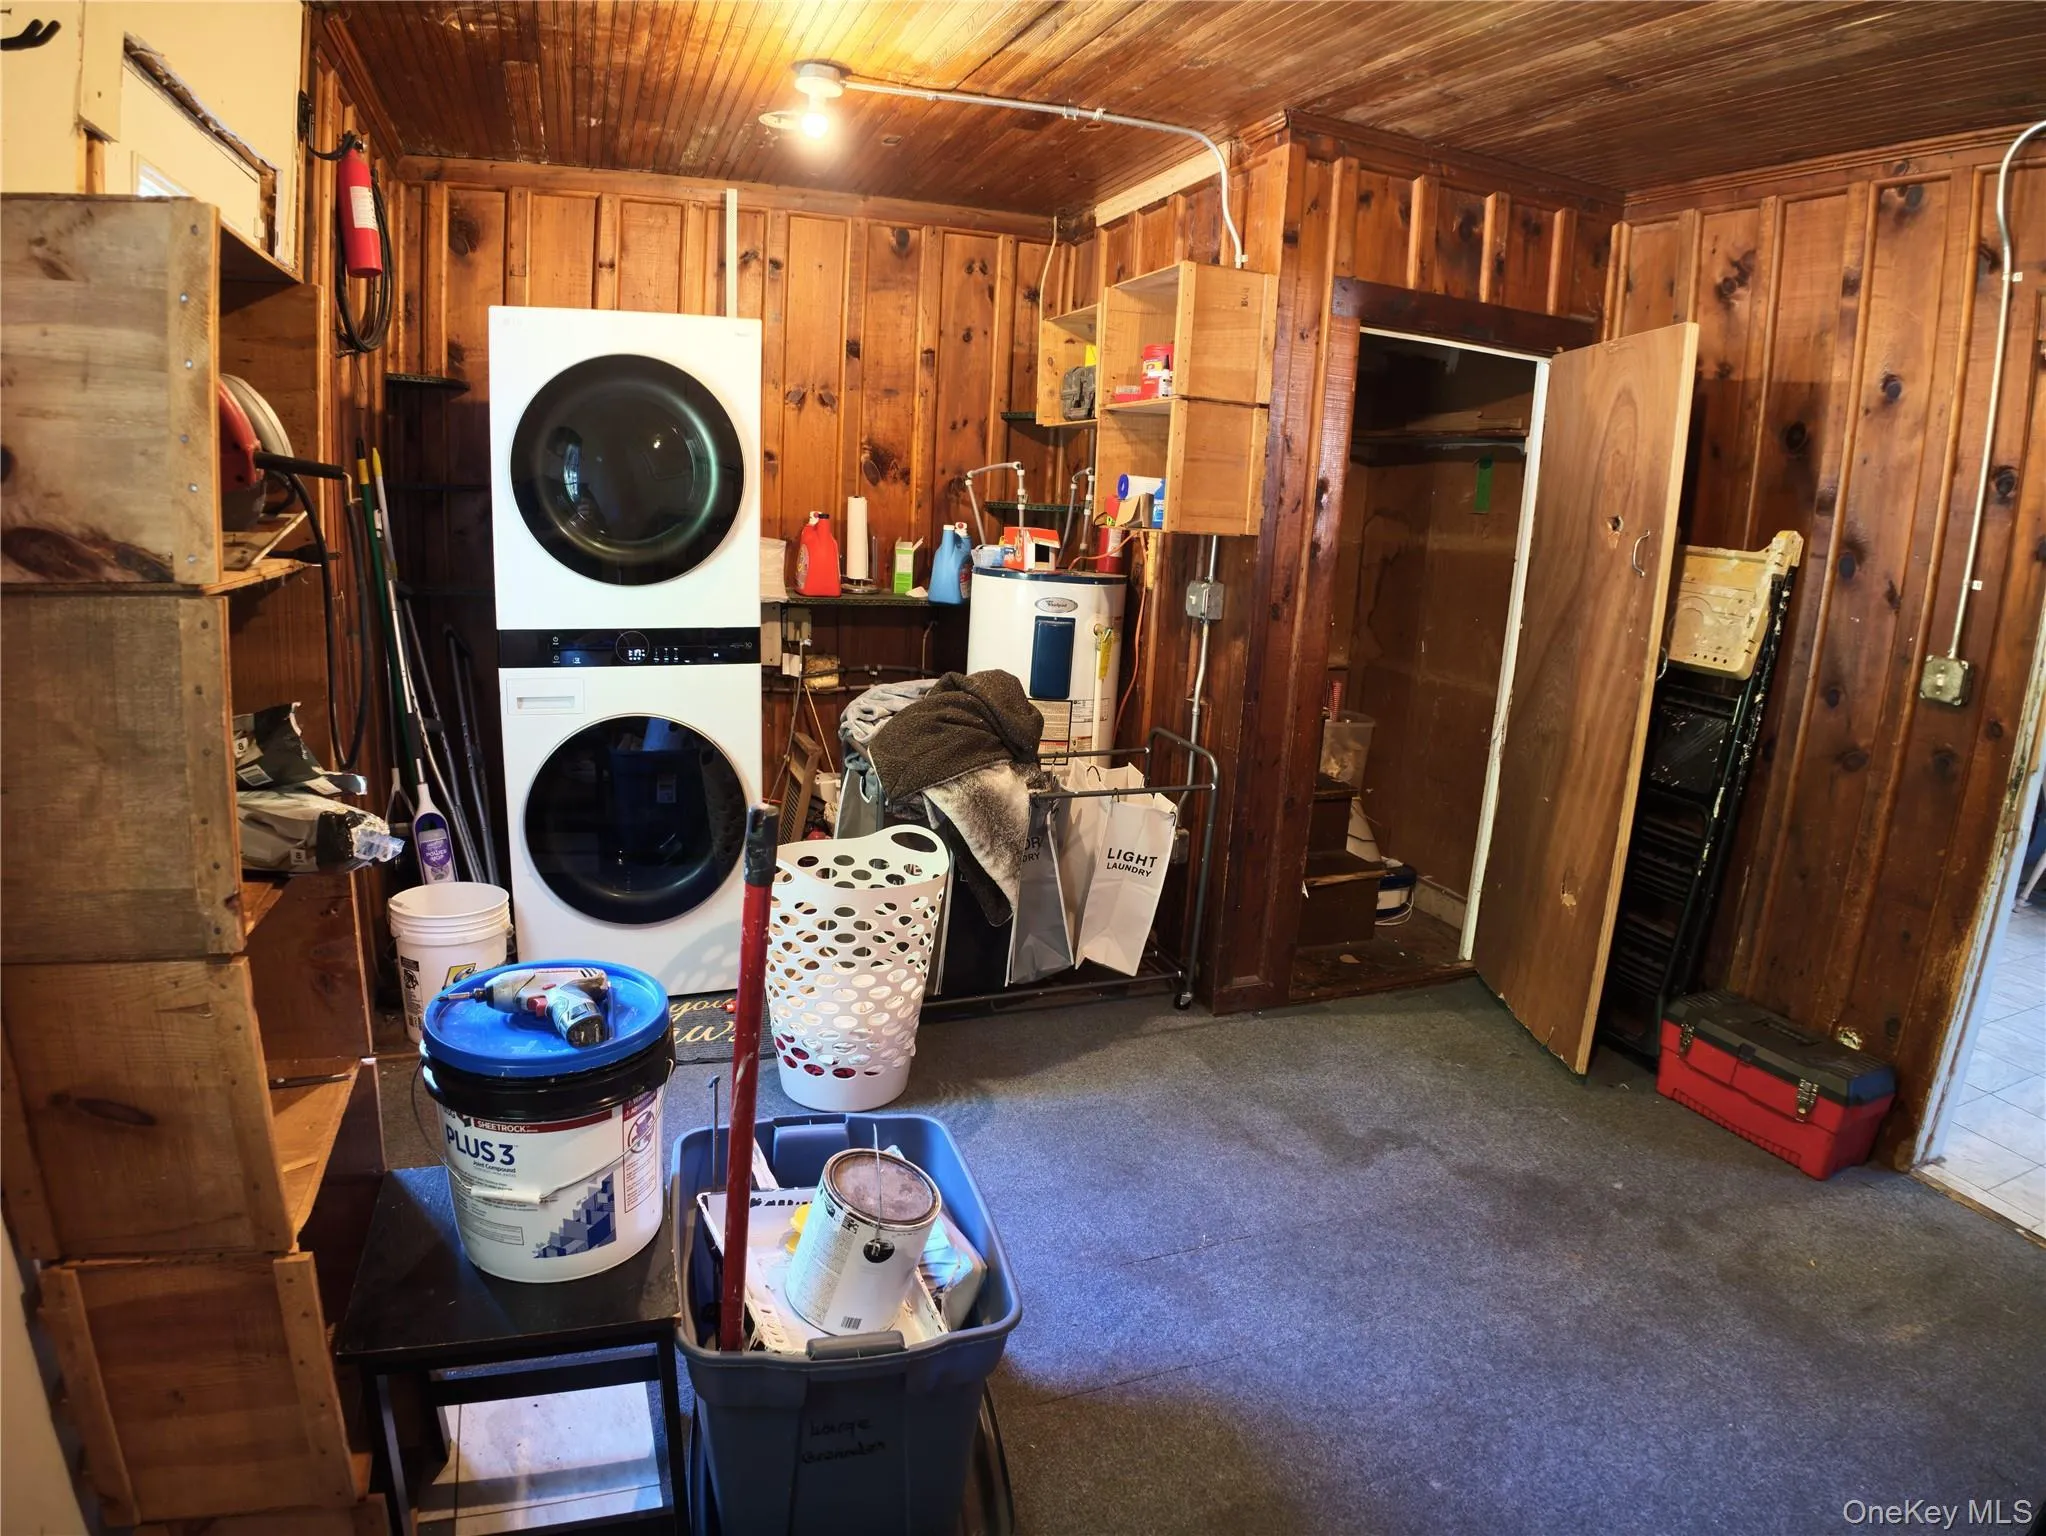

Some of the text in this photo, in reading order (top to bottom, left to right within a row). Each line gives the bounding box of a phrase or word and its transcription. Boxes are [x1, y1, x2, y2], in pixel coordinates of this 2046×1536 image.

[237, 742, 245, 751] 8
[1107, 847, 1158, 868] LIGHT
[1106, 862, 1152, 878] LAUNDRY
[477, 1120, 526, 1133] SHEETROCK
[446, 1123, 516, 1166] PLUS 3
